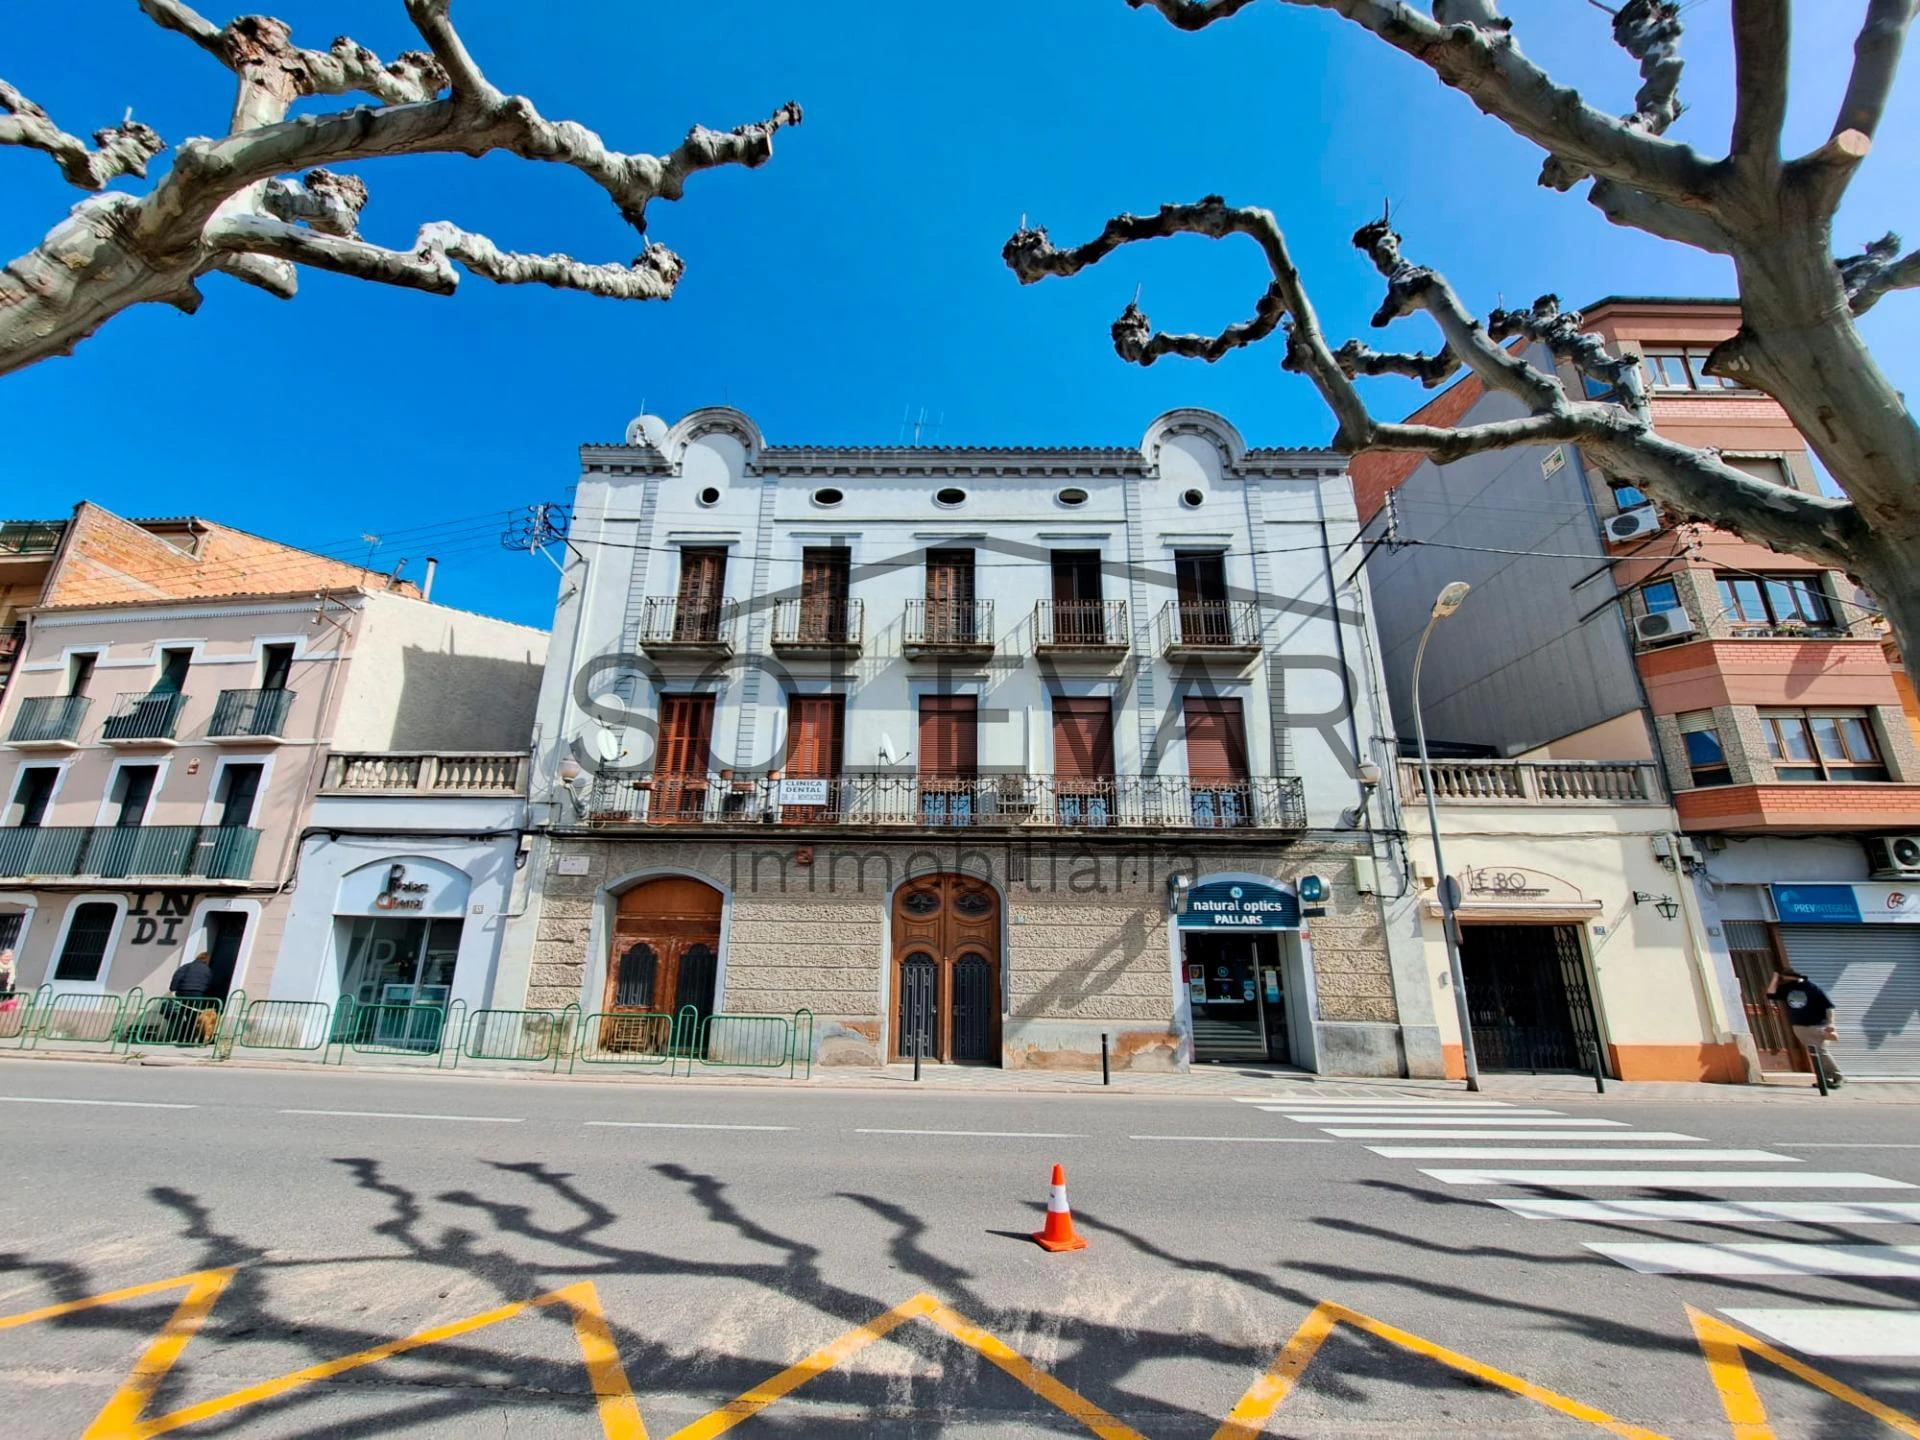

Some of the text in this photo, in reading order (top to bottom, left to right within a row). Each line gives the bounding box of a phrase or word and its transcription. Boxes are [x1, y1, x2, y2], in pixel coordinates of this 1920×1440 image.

[127, 889, 198, 916] IN
[1193, 900, 1282, 914] natural optics
[1214, 915, 1263, 925] PALLARS
[131, 917, 183, 945] DI
